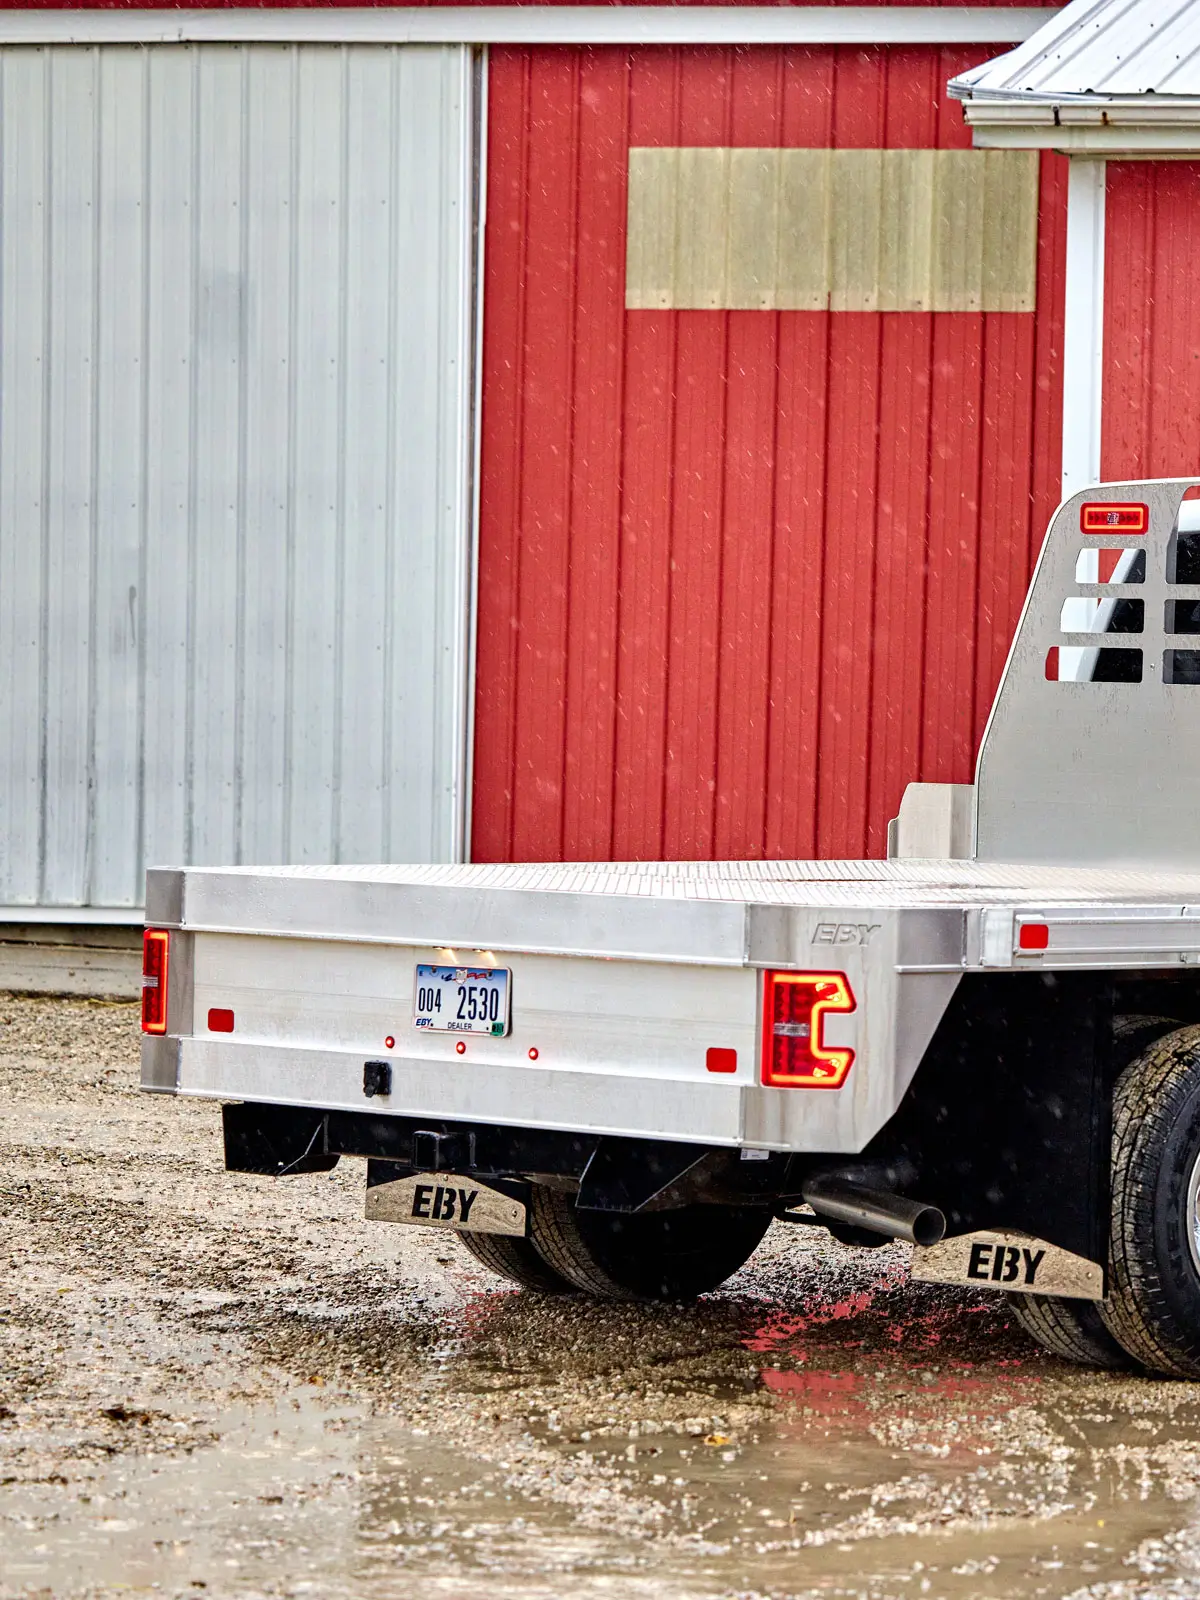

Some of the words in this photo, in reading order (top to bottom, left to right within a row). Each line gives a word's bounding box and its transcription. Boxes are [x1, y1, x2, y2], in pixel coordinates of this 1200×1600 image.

[811, 923, 882, 946] EBY
[418, 987, 441, 1013] 004
[456, 986, 499, 1021] 2530
[416, 1018, 432, 1026] EBY
[447, 1021, 472, 1031] DEALER
[411, 1184, 479, 1223] EBY
[967, 1242, 1046, 1285] EBY
